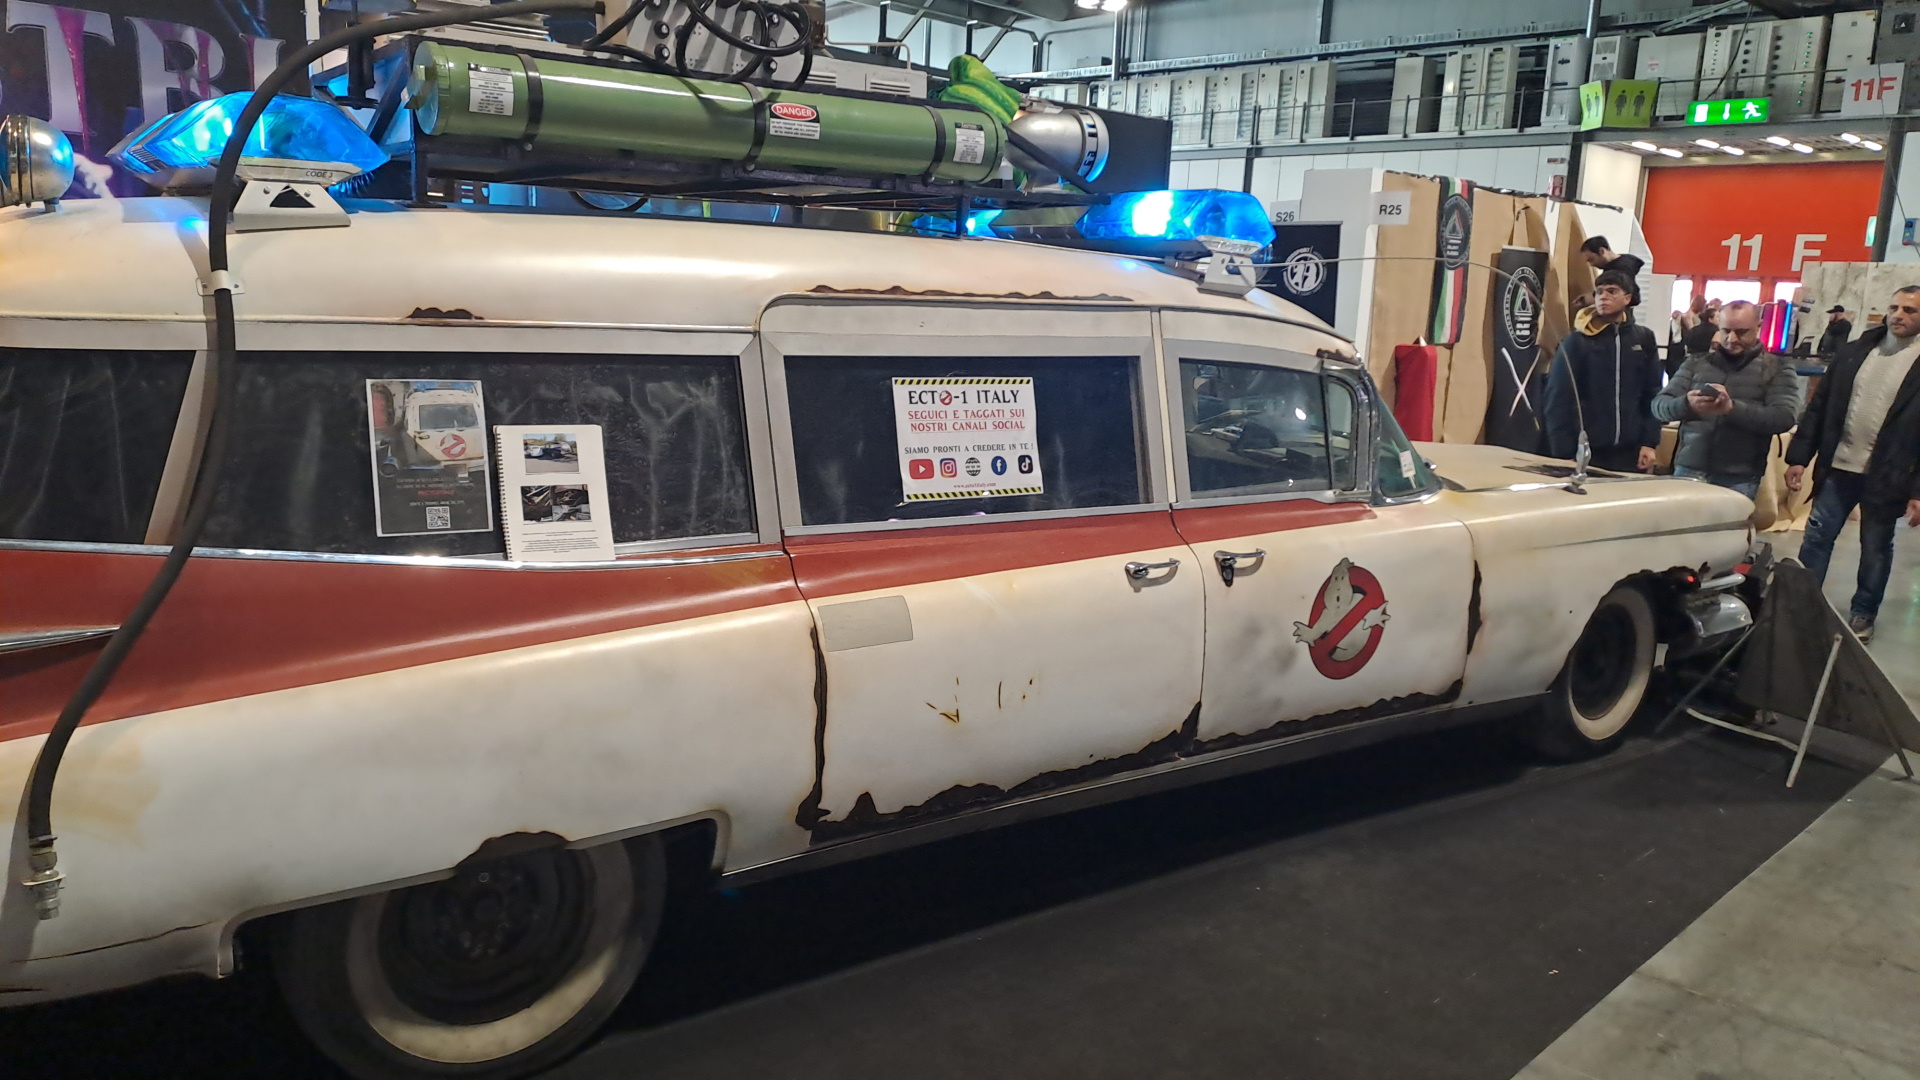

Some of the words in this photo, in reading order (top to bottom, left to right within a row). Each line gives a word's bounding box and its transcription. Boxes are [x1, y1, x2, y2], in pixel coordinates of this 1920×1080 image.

[1850, 76, 1898, 102] 11F
[775, 106, 812, 117] DANGER
[305, 170, 327, 178] CODE
[1379, 204, 1403, 216] R25
[1275, 211, 1295, 223] S26
[1721, 233, 1763, 271] 11
[1791, 233, 1828, 272] F
[977, 389, 1020, 404] ITALY
[907, 410, 948, 420] SEGUICI
[953, 409, 960, 419] E
[963, 409, 1005, 419] TAGGATI
[1009, 408, 1025, 418] SUI
[910, 422, 947, 432] NOSTRI
[952, 421, 987, 431] CANALI
[992, 420, 1025, 430] SOCIAL
[933, 445, 961, 453] PRONTI
[972, 443, 1006, 452] CREDERE
